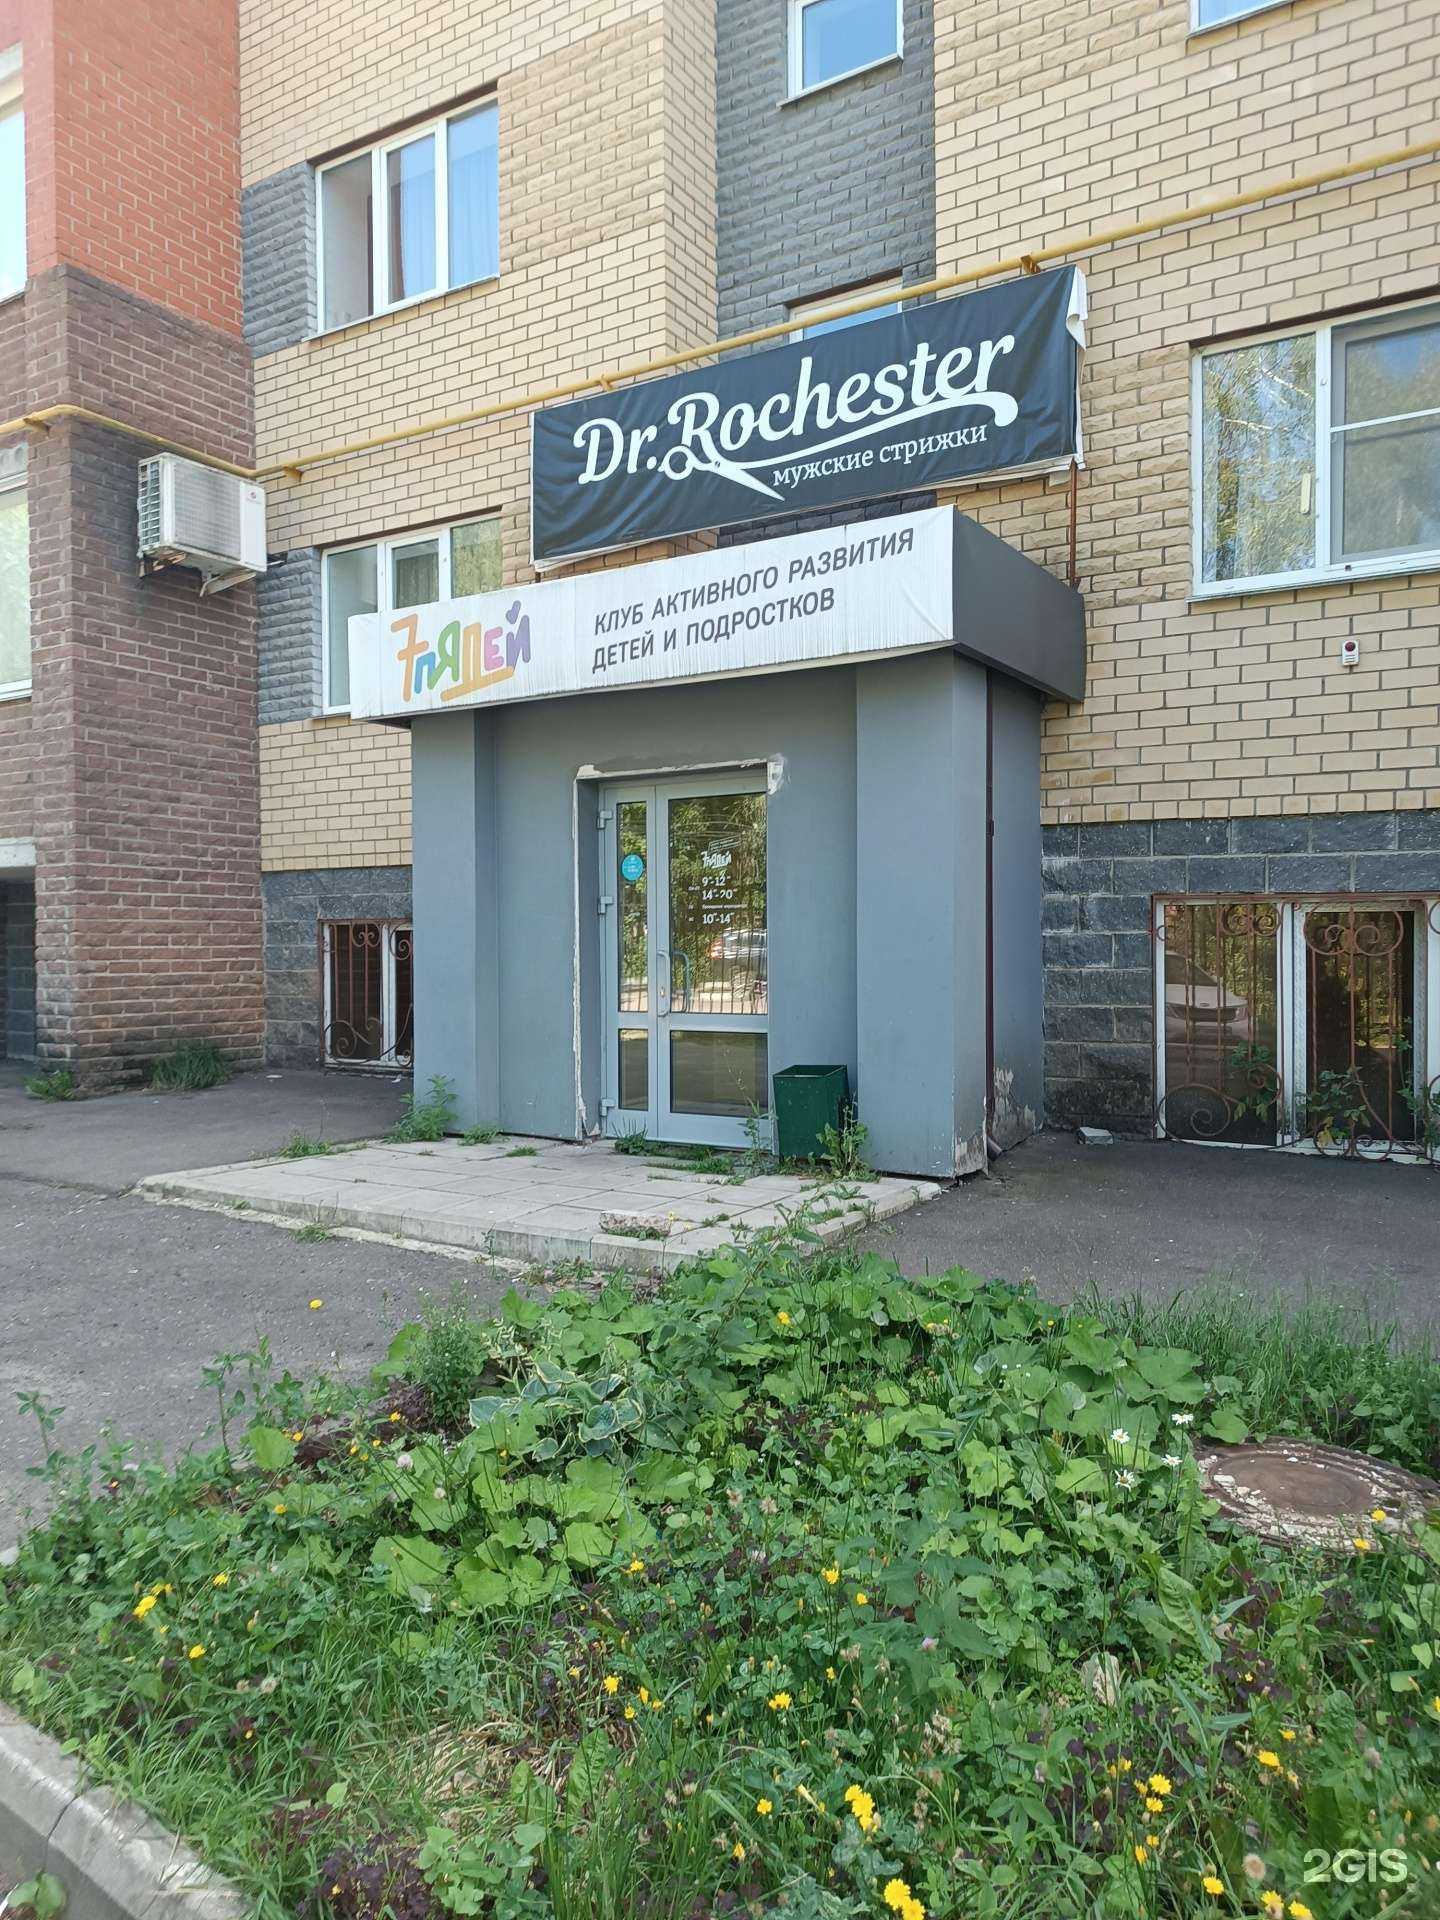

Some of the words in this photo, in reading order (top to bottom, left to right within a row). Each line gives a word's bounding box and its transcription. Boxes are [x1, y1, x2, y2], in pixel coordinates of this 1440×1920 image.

[773, 447, 873, 488] мужские
[879, 424, 988, 466] стрижки
[594, 603, 643, 636] КЛУБ
[651, 566, 779, 621] АКТИВНОГО
[788, 528, 915, 584] РАЗВИТИЯ
[592, 630, 655, 674] ДЕТЕЙ
[663, 628, 677, 652] И
[686, 587, 835, 646] ПОДРОСТКОВ
